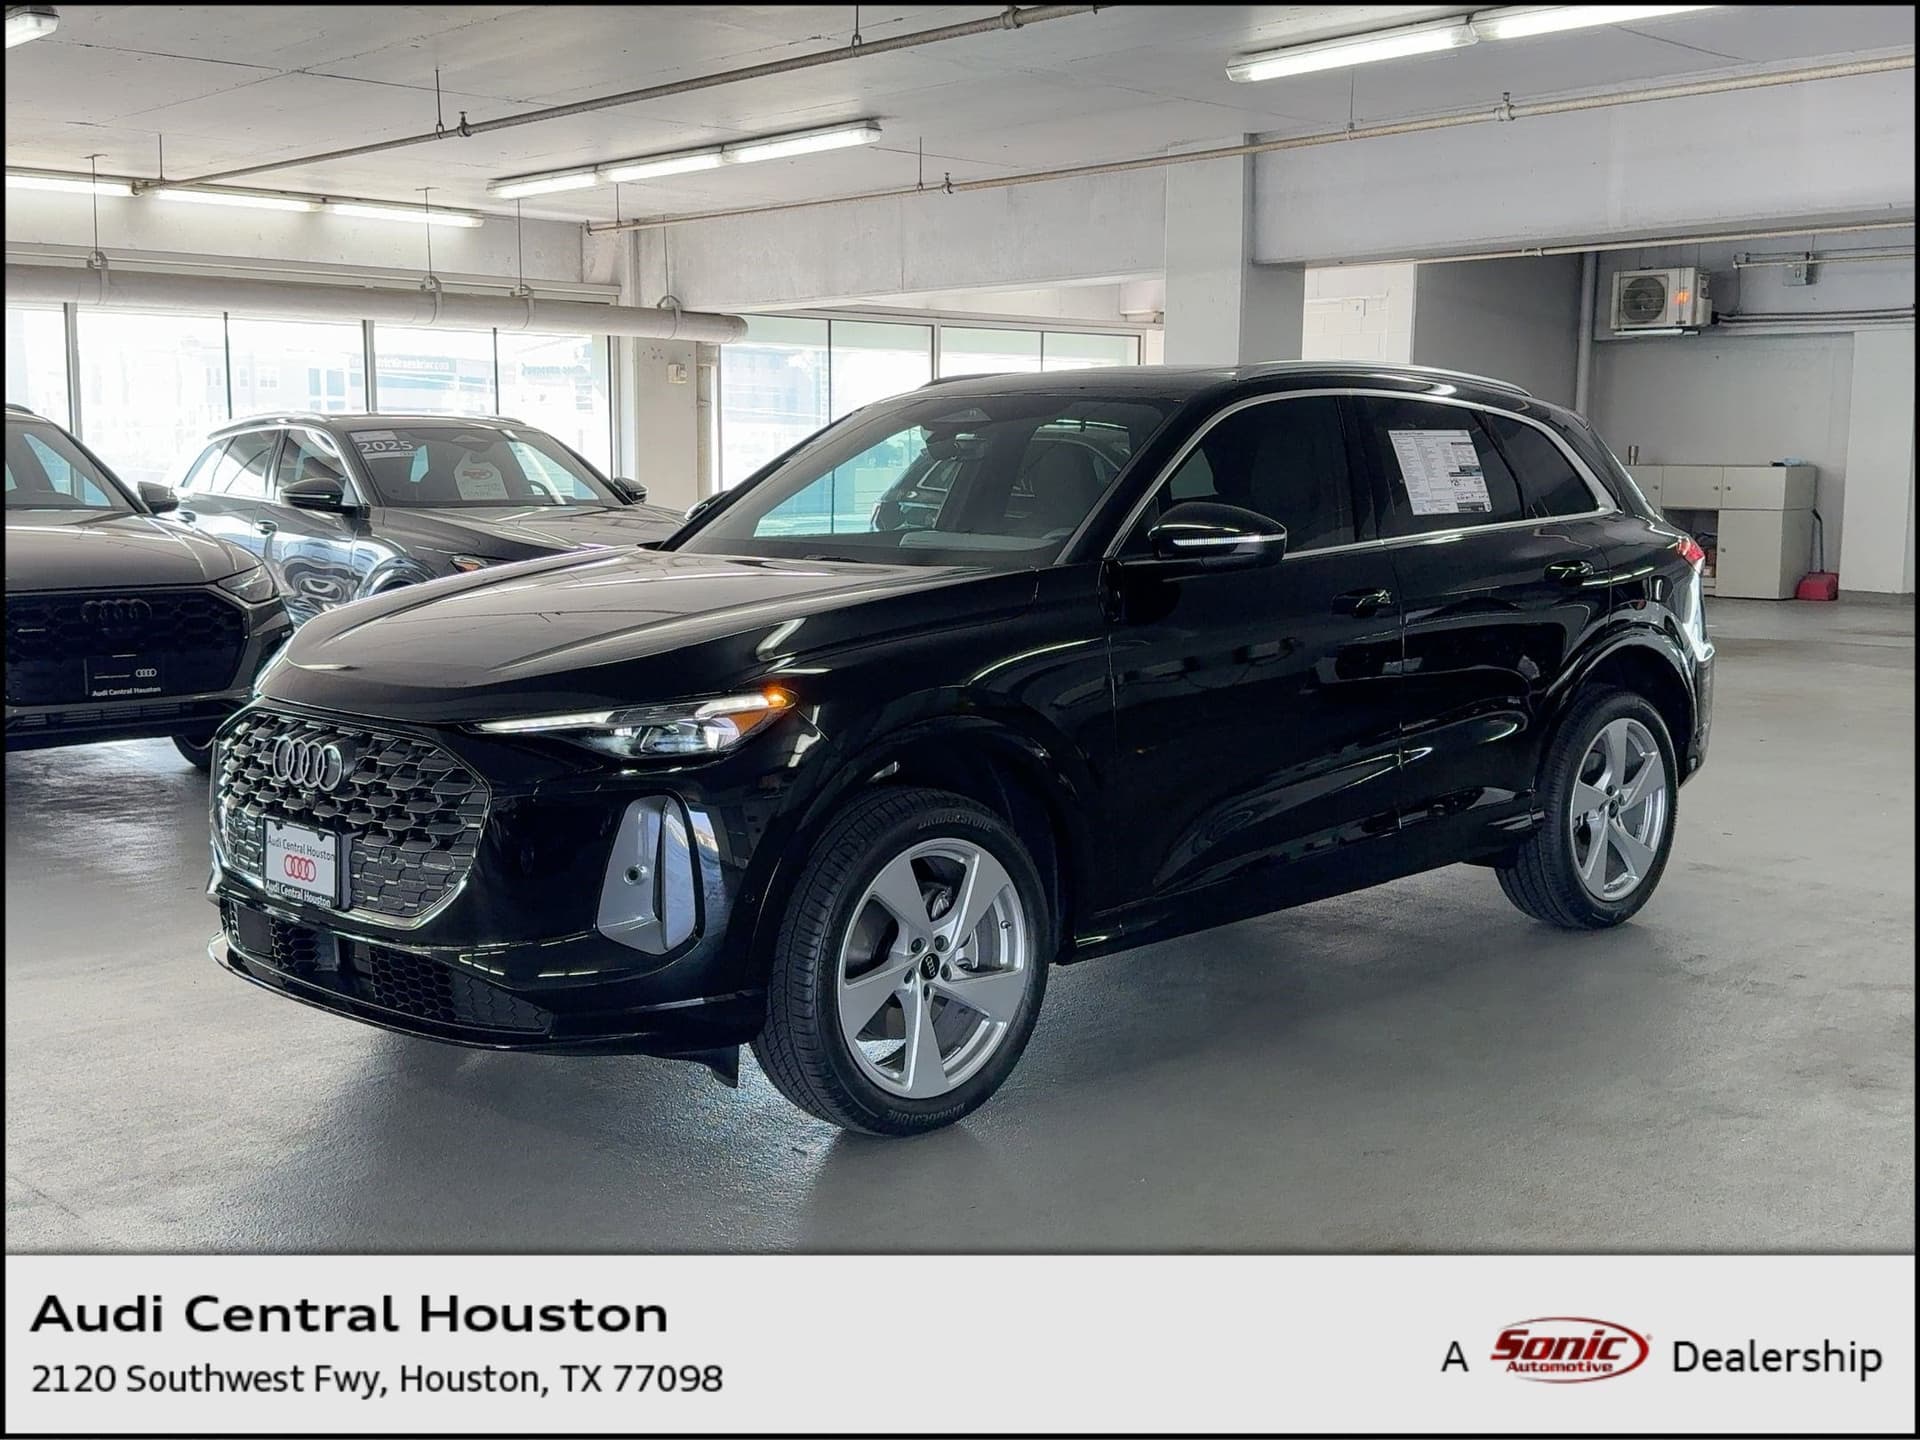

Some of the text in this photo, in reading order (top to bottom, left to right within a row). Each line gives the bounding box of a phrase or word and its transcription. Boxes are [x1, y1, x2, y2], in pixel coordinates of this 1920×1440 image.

[358, 440, 414, 453] 2025
[109, 688, 133, 696] Central
[283, 839, 306, 855] Central
[307, 846, 335, 862] Houston
[267, 880, 331, 908] Audi Central Houston
